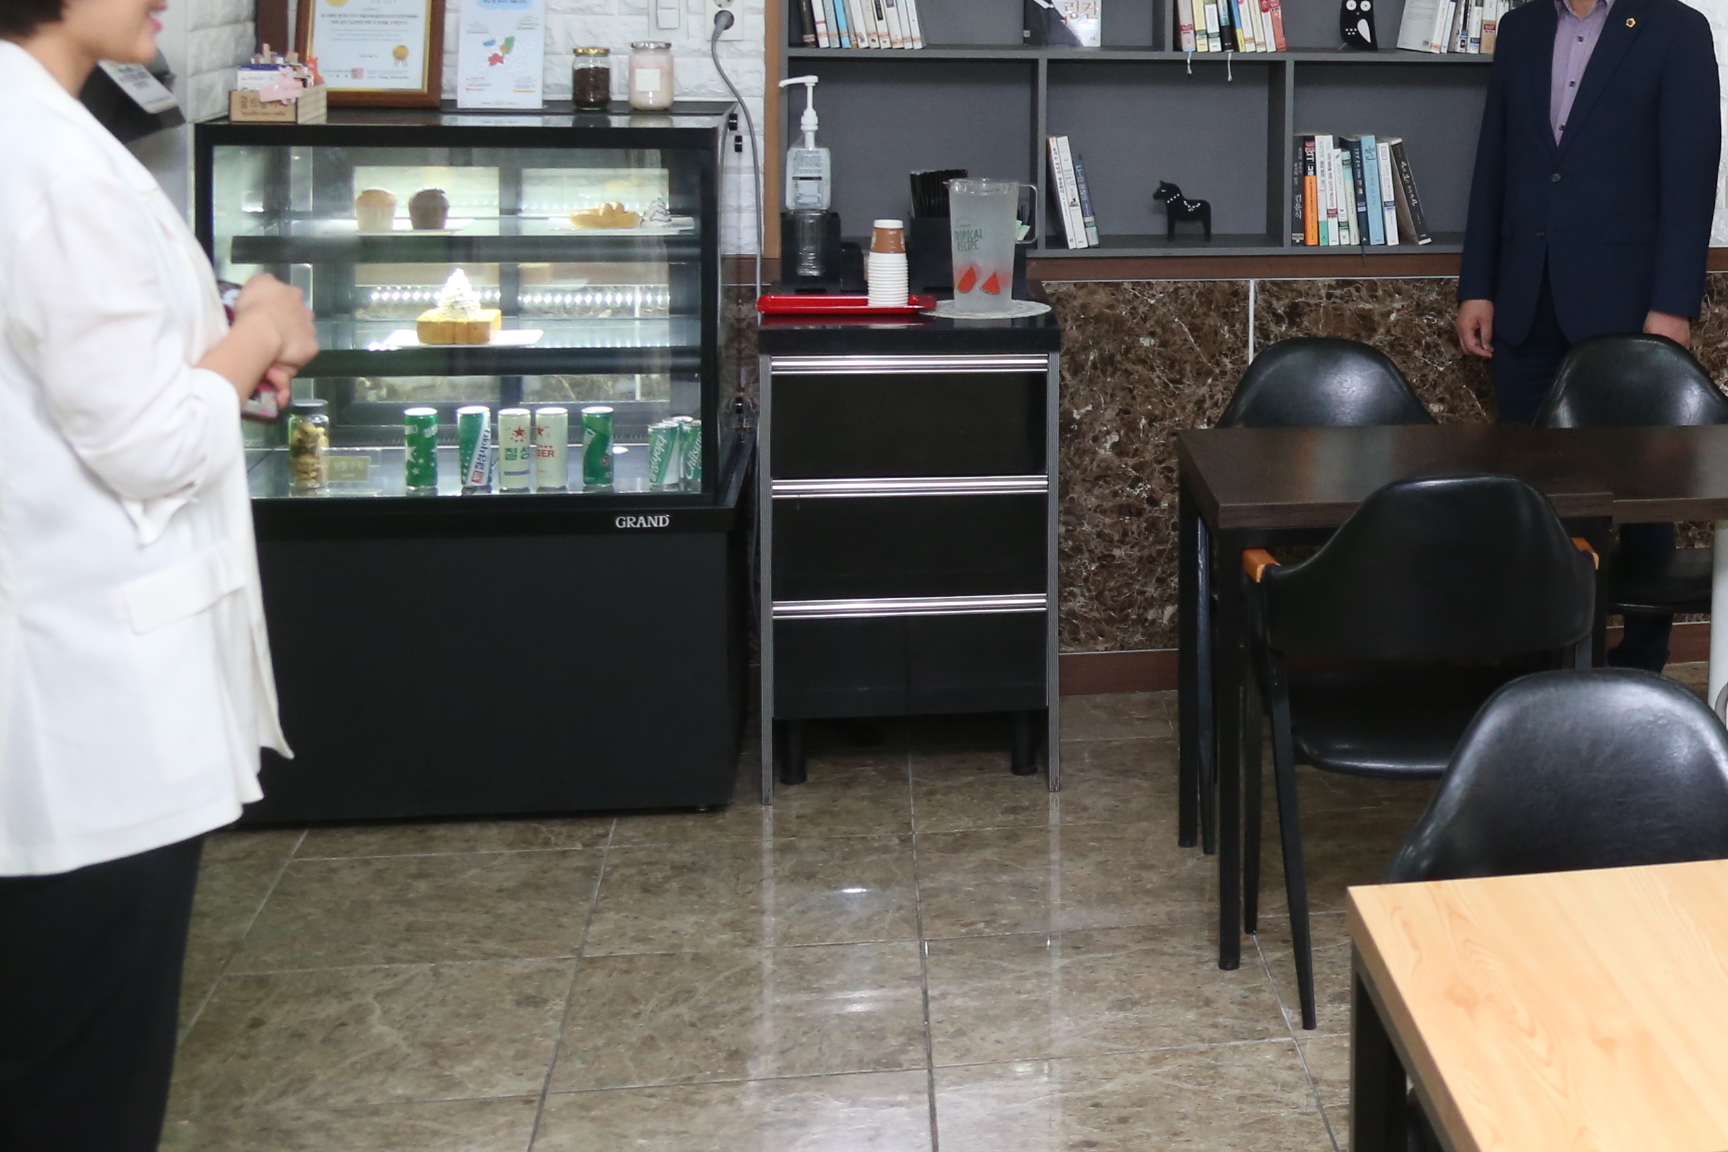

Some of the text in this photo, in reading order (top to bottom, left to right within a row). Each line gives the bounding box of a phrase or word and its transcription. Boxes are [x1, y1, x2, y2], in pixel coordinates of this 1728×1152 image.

[1064, 0, 1097, 20] 링컨
[474, 429, 491, 471] 칠성사이다
[615, 515, 670, 529] GRAND
